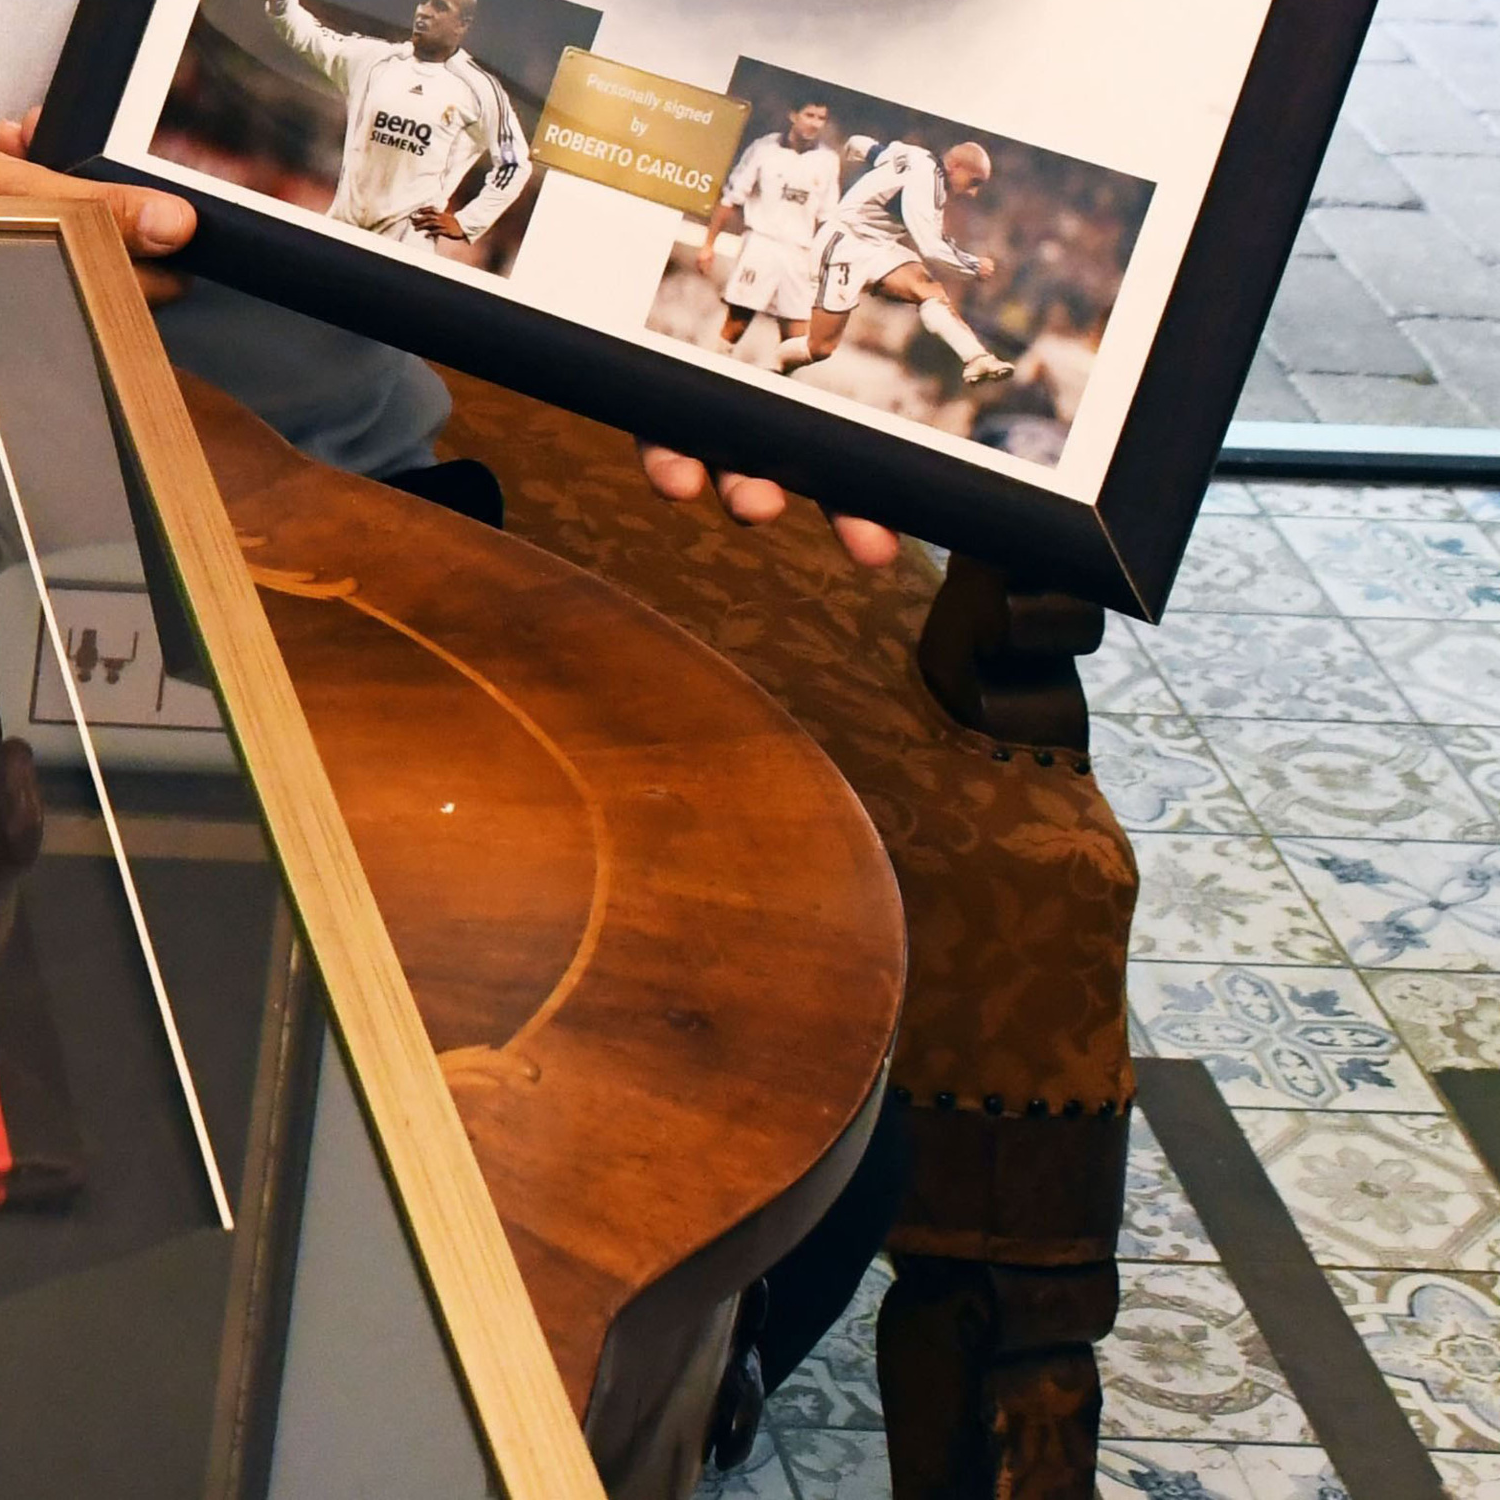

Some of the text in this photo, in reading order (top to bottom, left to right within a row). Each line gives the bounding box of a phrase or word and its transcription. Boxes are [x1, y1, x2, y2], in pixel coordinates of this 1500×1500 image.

[586, 73, 714, 126] Personally signed
[370, 131, 427, 156] SIEMENS
[630, 116, 649, 137] by
[544, 124, 713, 194] ROBERTO CARLOS
